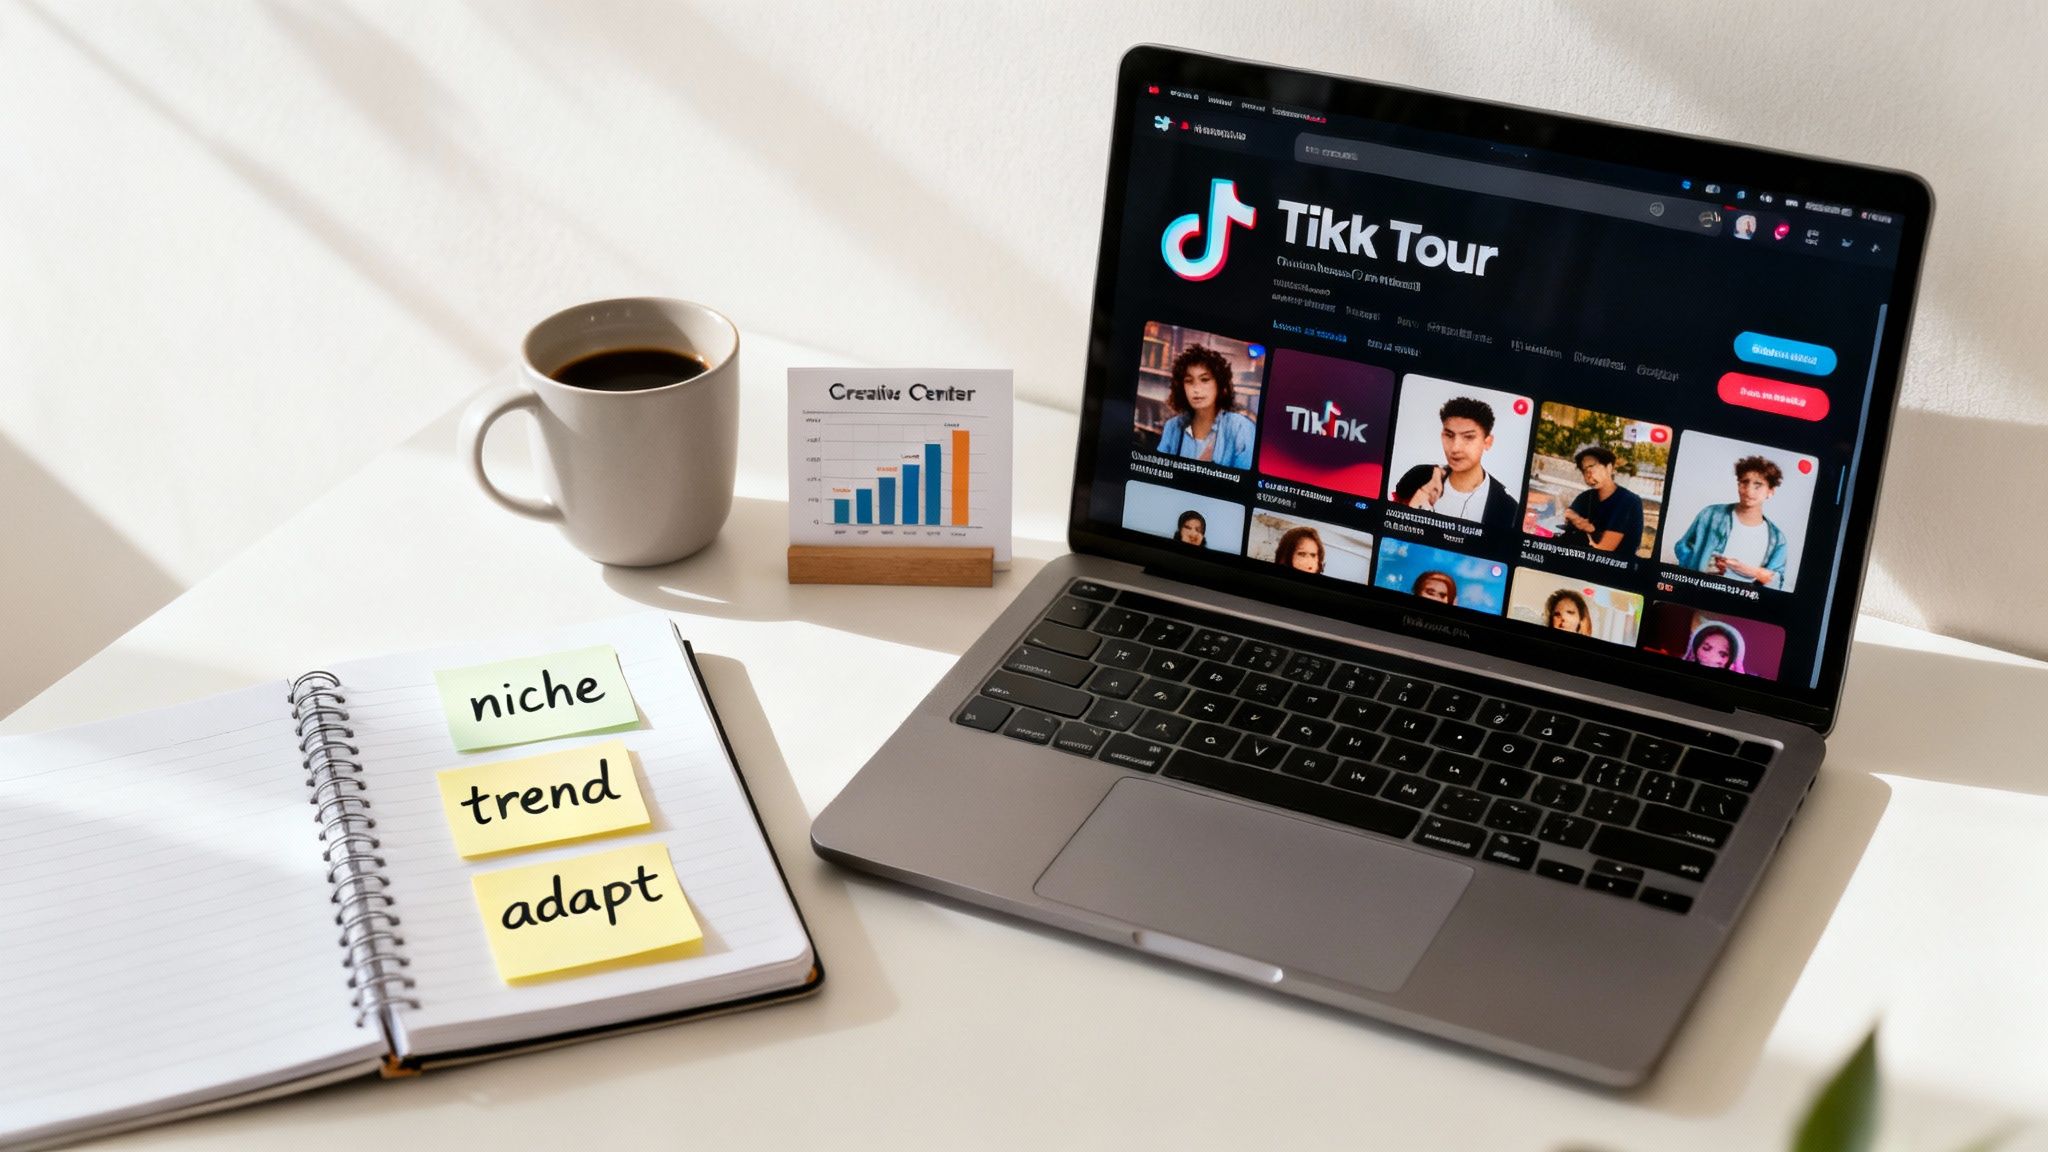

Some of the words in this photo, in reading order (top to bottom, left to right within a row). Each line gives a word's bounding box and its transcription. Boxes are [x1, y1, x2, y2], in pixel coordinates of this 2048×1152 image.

[1278, 199, 1380, 259] Tikk
[1389, 219, 1499, 276] Tour
[470, 669, 606, 722] niche
[460, 758, 622, 825] trend
[501, 865, 663, 929] adapt
